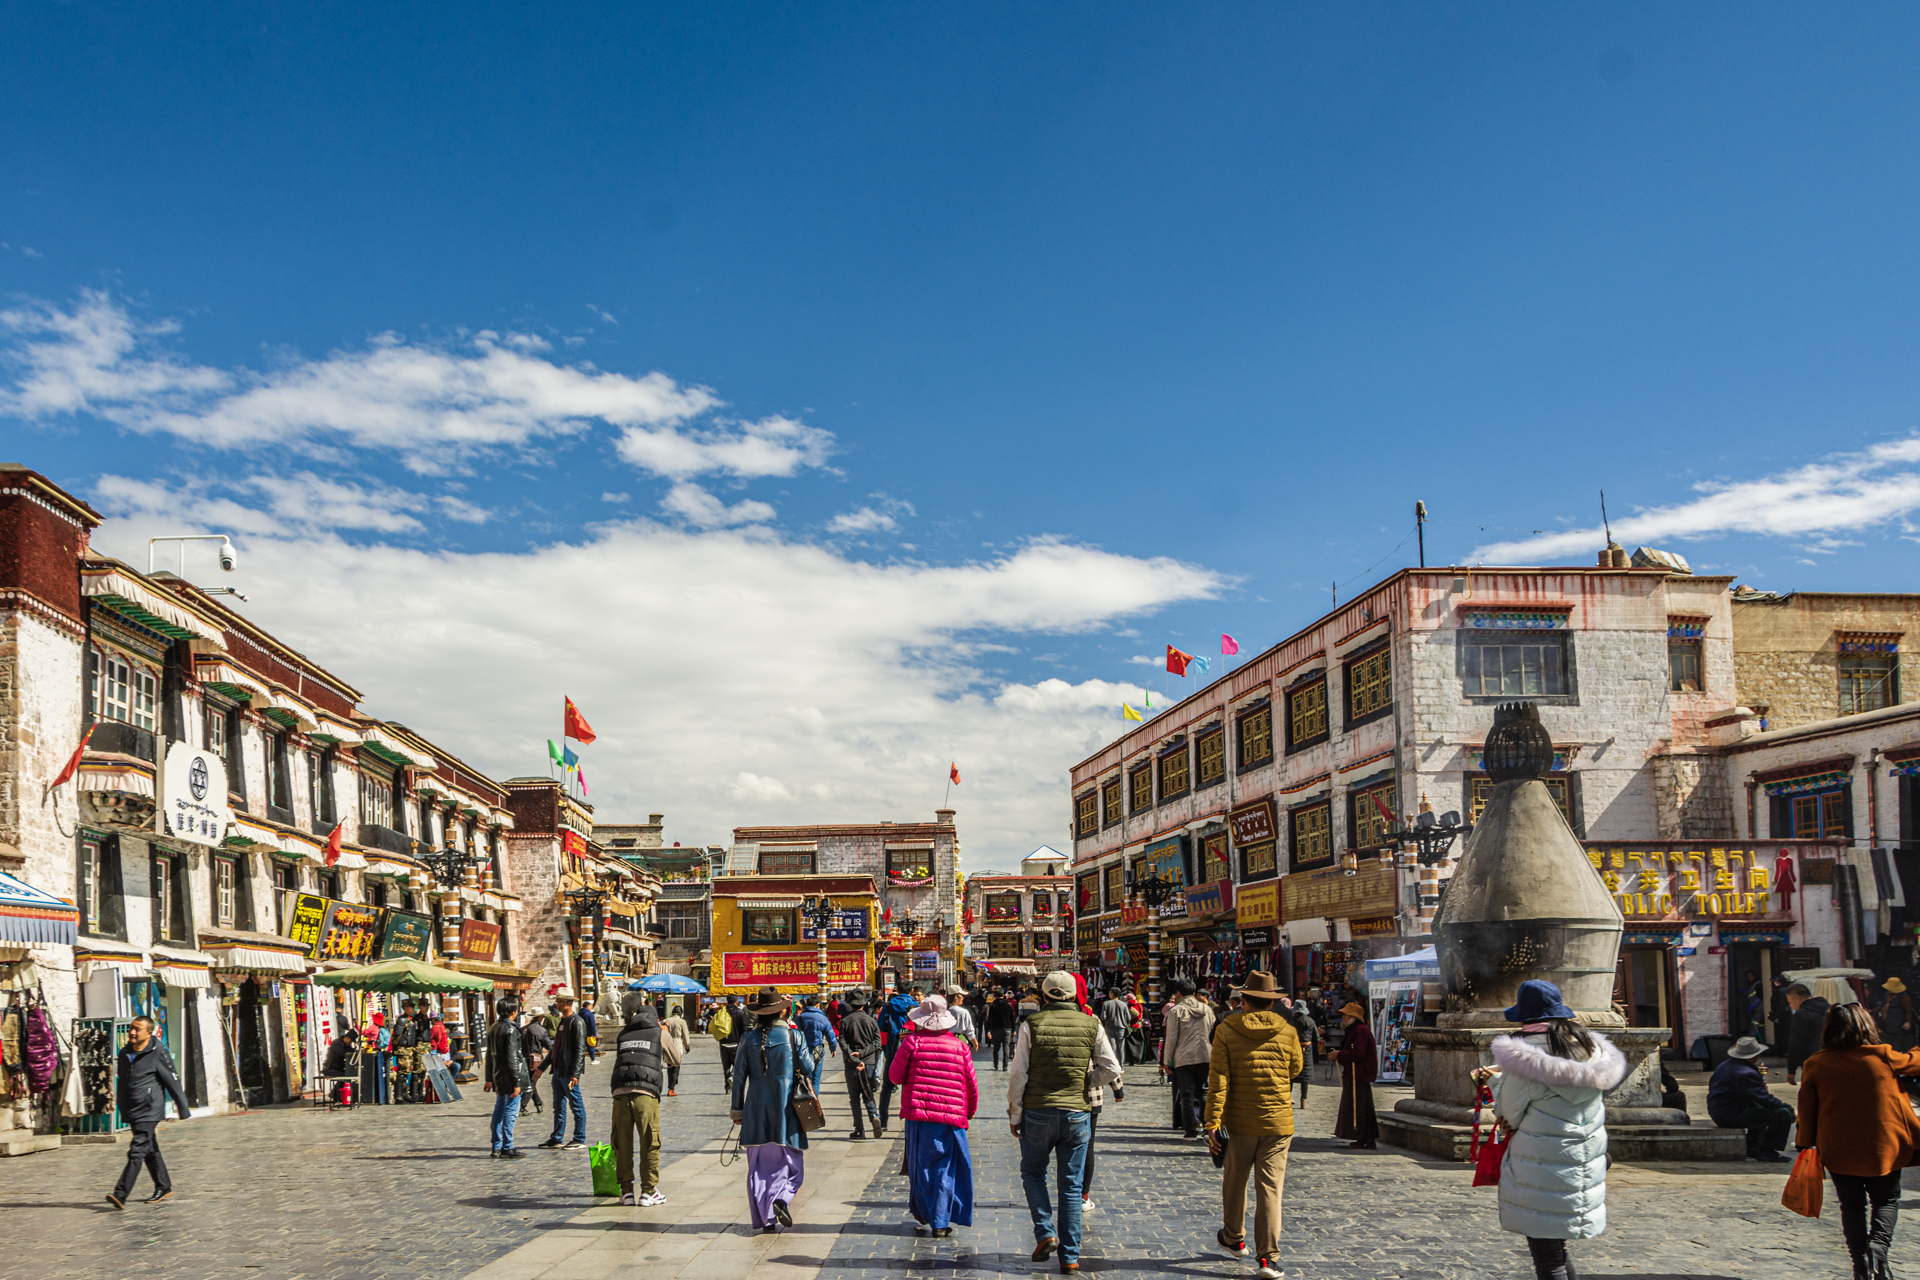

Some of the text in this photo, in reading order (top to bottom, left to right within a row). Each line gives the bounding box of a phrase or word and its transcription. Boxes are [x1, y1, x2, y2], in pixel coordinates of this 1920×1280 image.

[1602, 868, 1770, 891] 公共卫生间
[1613, 892, 1770, 915] BLIC TOILET
[752, 961, 862, 976] 热烈庆祝中华人民共和成立70周年!
